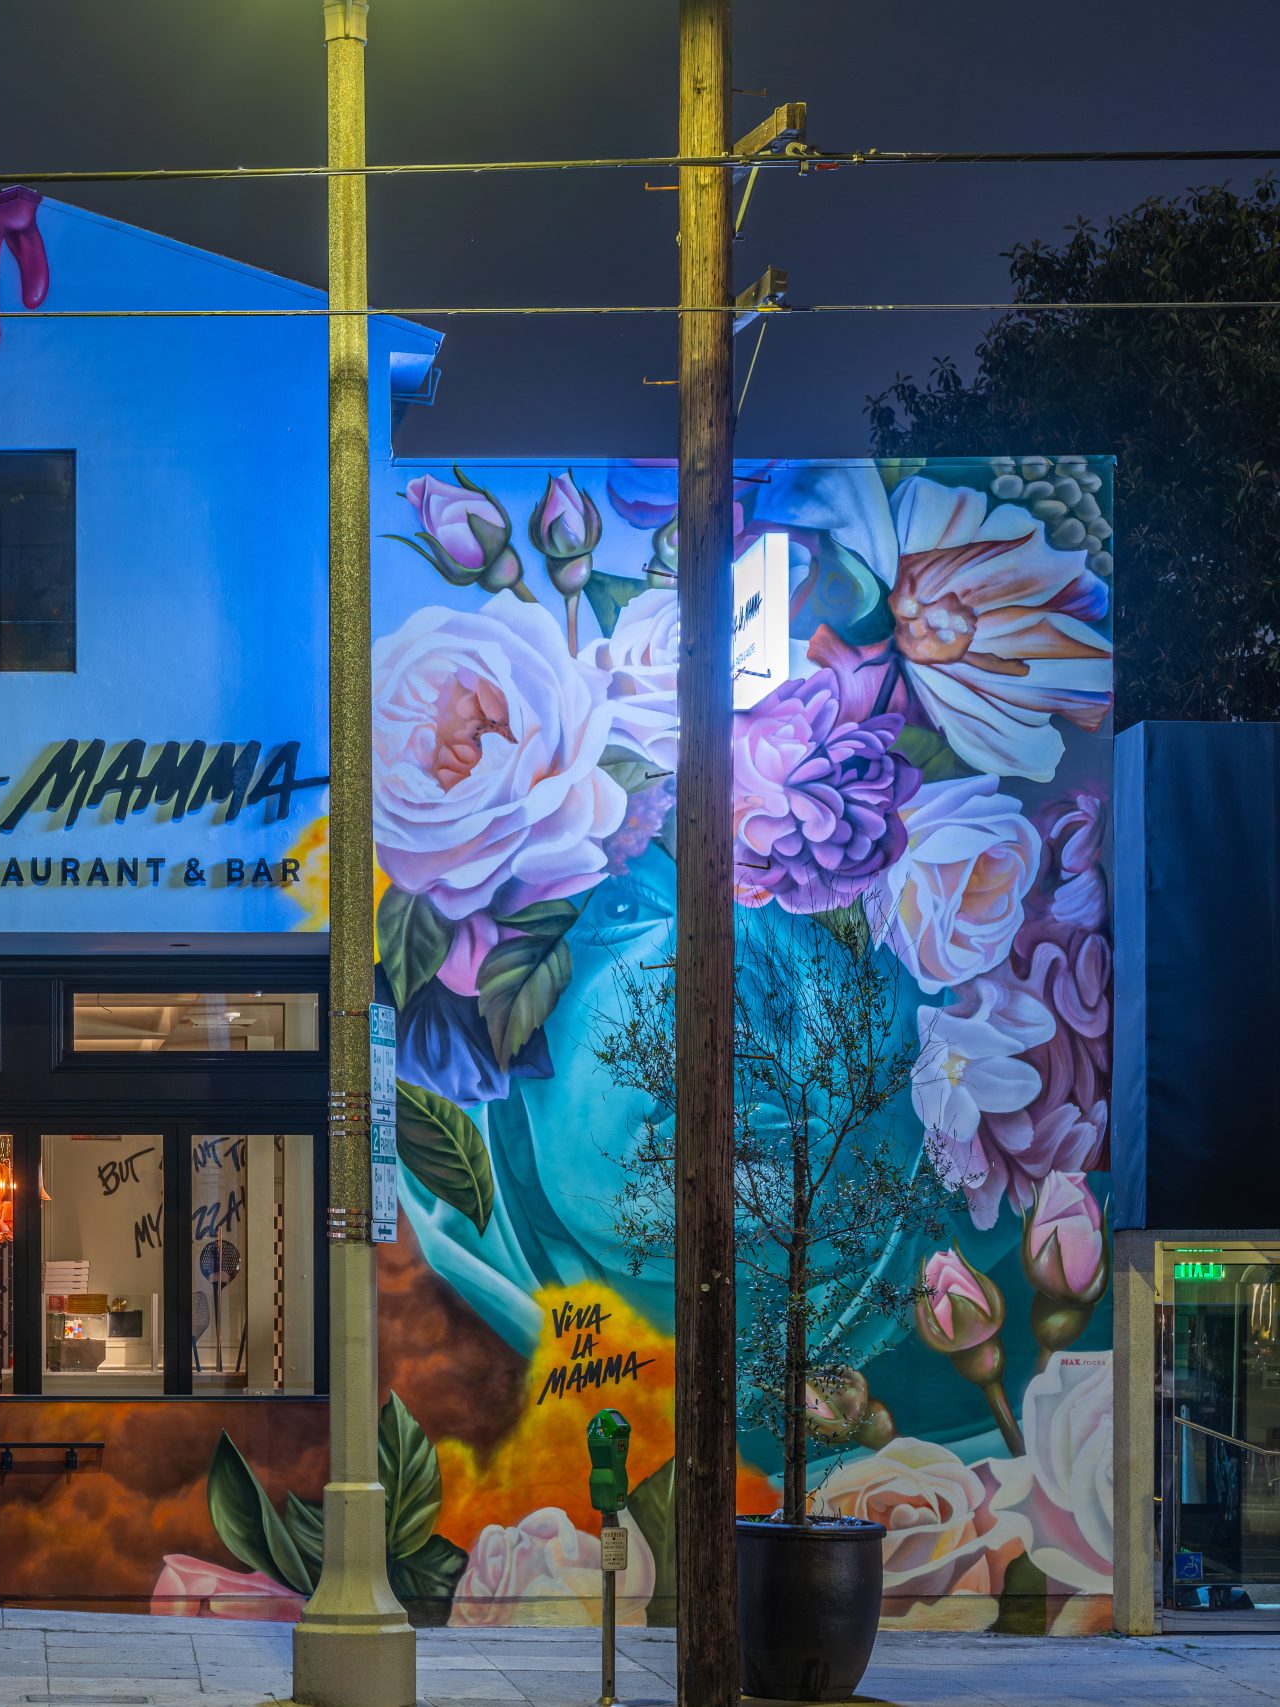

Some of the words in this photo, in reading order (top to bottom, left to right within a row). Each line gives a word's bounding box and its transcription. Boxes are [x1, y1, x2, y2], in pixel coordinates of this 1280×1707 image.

[0, 738, 330, 833] MAMMA
[184, 857, 208, 886] &
[226, 857, 300, 886] BAR
[373, 1128, 379, 1151] 2
[98, 1147, 155, 1196] BUT
[134, 1202, 164, 1258] MY
[571, 1334, 599, 1360] LA
[537, 1351, 656, 1405] MAMMA
